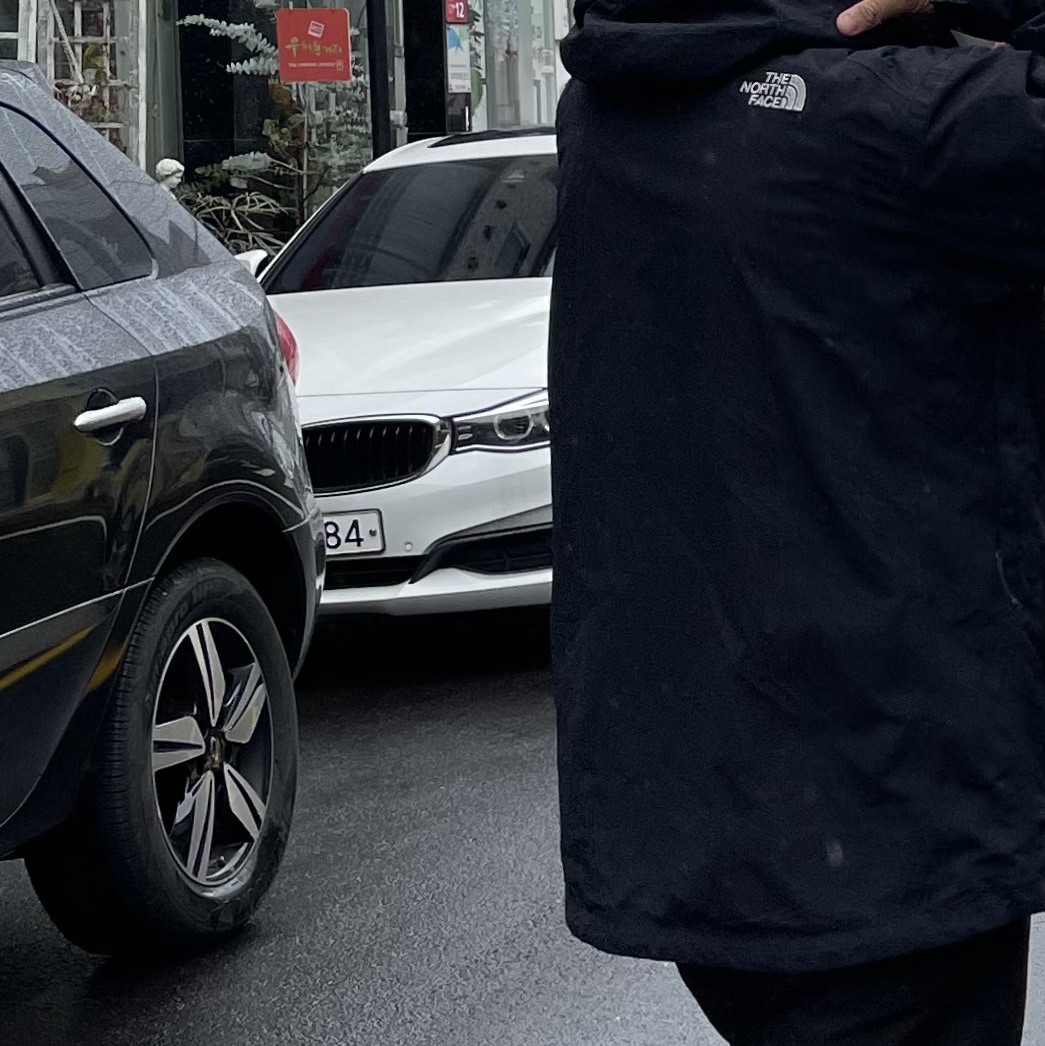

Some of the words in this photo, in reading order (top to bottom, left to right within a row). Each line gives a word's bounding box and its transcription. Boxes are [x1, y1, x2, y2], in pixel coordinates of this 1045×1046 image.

[766, 71, 791, 84] THE
[739, 81, 787, 96] NORTH
[748, 94, 782, 108] FACE
[324, 519, 364, 549] 84
